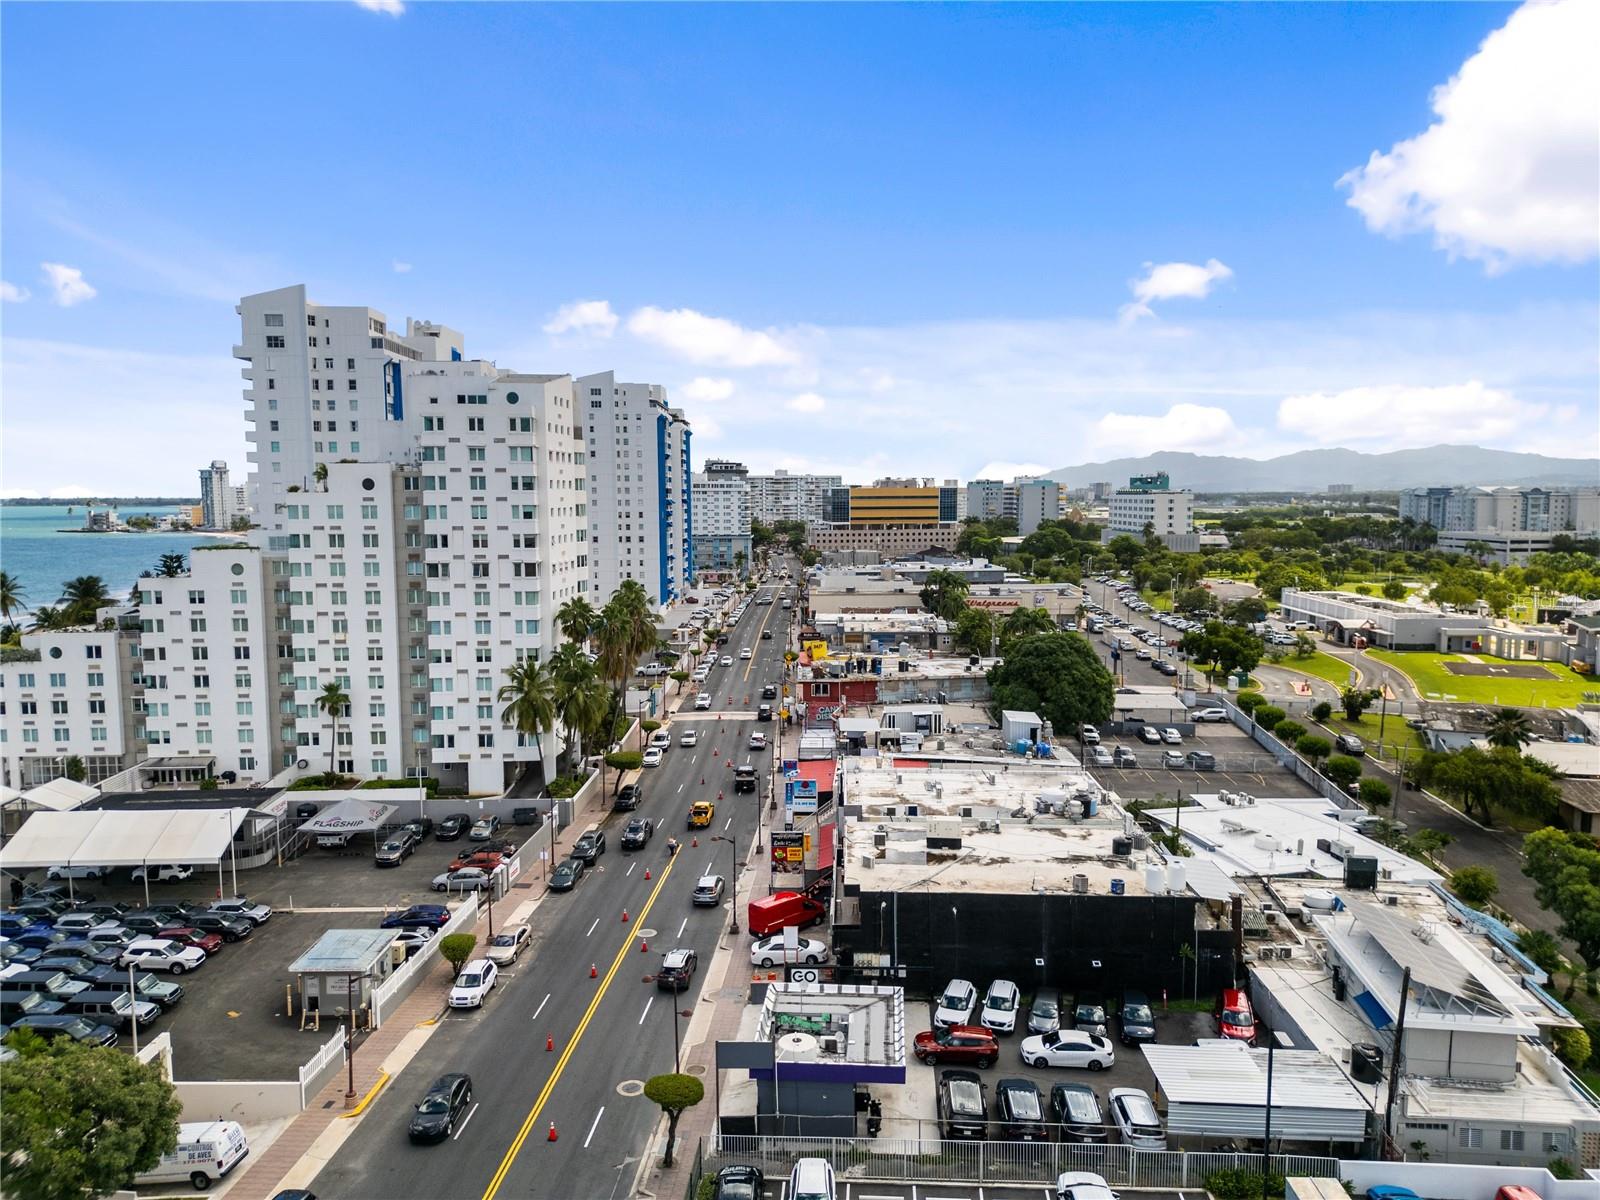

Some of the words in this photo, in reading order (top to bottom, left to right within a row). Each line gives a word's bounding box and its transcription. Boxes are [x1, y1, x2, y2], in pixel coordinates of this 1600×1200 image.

[313, 820, 364, 828] FLAGSHIP
[792, 970, 816, 982] GO
[187, 1143, 214, 1152] CONTROL
[188, 1152, 196, 1160] DE
[197, 1151, 212, 1159] AVES
